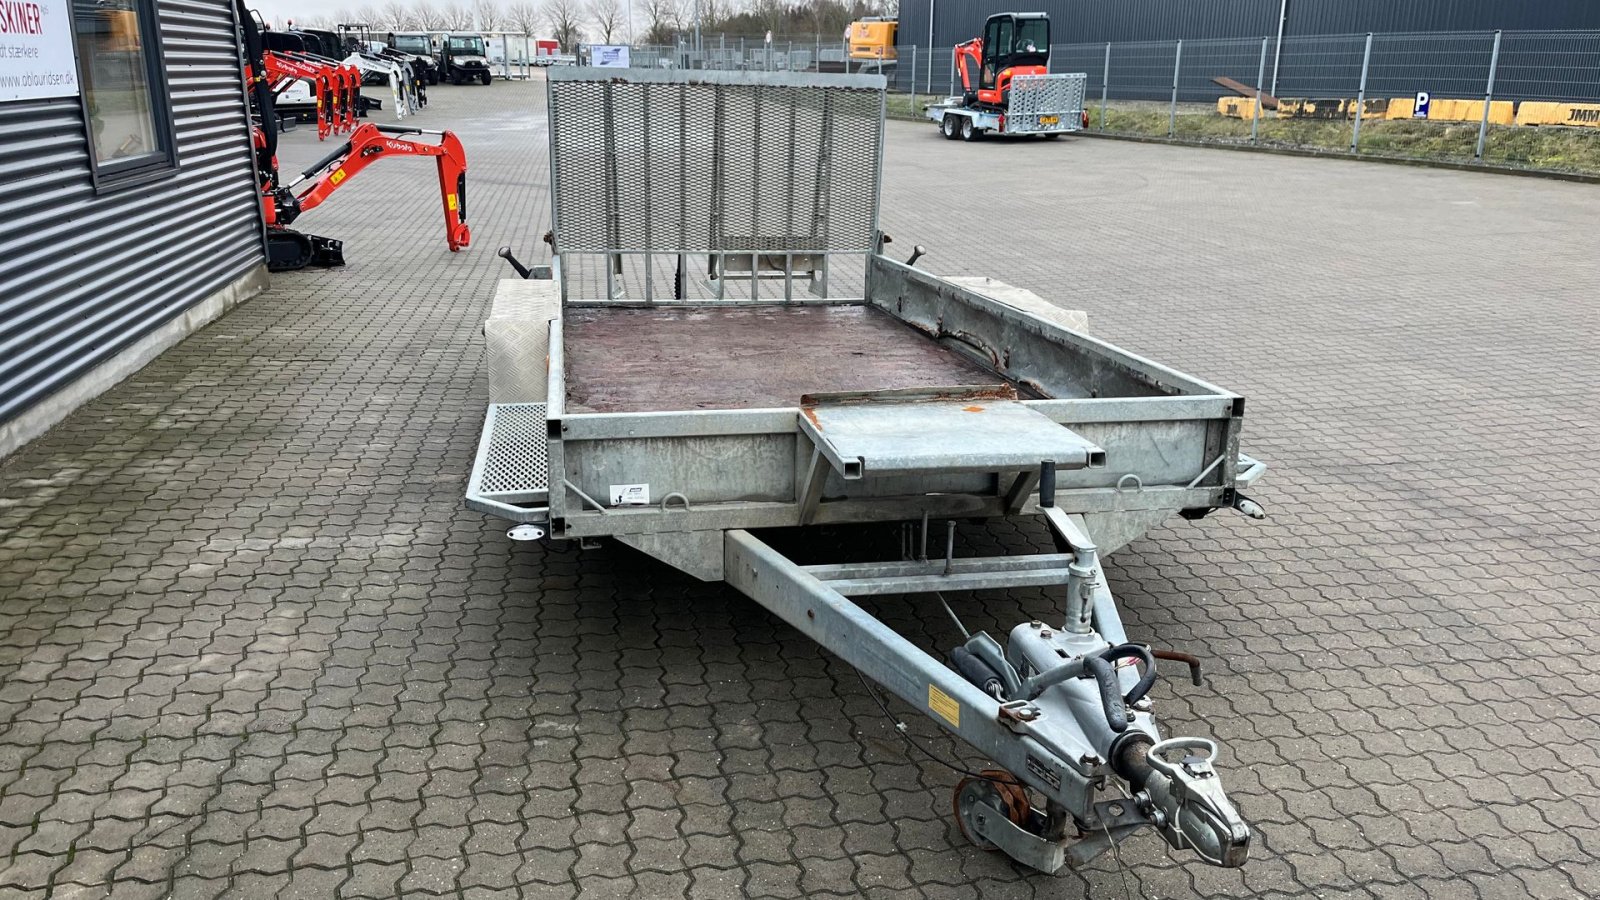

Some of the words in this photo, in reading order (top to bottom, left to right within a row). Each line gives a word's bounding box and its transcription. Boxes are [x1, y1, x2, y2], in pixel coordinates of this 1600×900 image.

[8, 44, 39, 58] stærkere
[1415, 92, 1429, 112] P
[1567, 108, 1600, 122] JMM
[386, 140, 413, 152] Kubota
